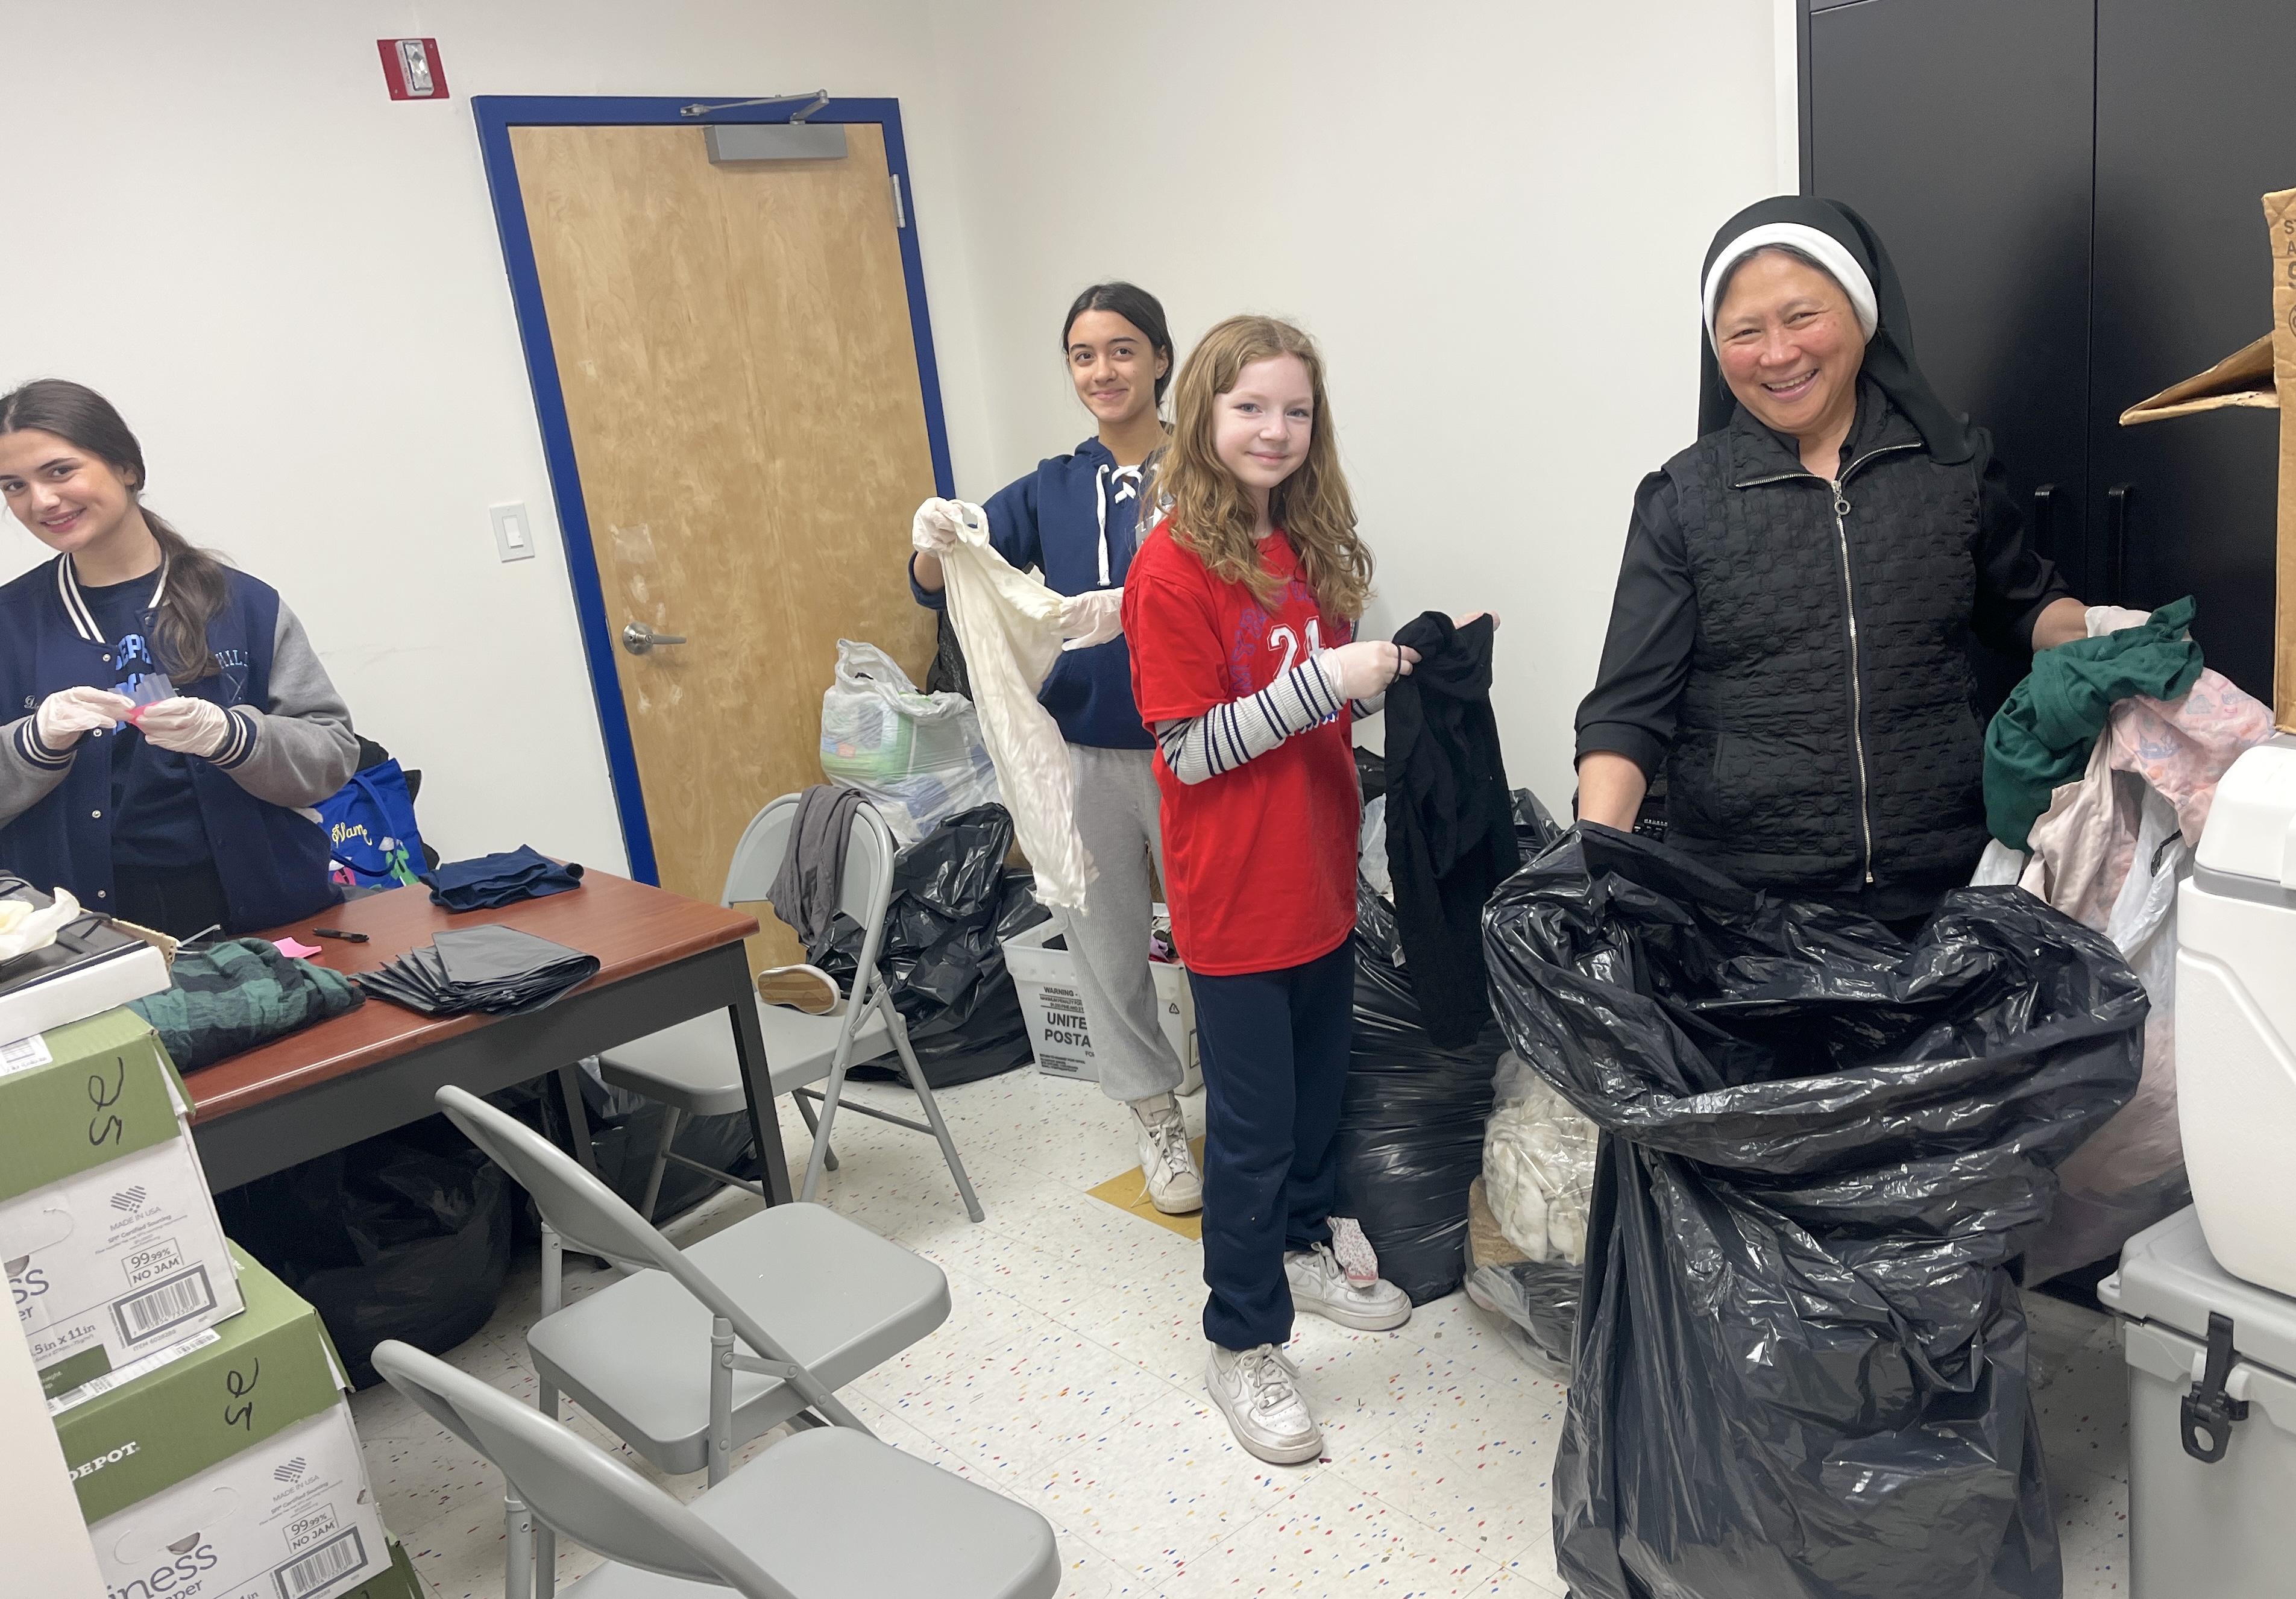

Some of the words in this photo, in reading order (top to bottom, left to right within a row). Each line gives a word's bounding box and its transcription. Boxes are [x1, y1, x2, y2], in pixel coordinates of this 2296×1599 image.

[1267, 615, 1326, 680] 24
[1044, 987, 1074, 996] WARNING
[1047, 1012, 1087, 1030] UNITE
[1045, 1028, 1091, 1048] POSTA
[110, 1216, 134, 1231] MADE
[134, 1212, 144, 1221] IN
[145, 1206, 162, 1216] USA
[132, 1269, 151, 1284] NO
[68, 1325, 96, 1341] 11in
[272, 1486, 295, 1502] MADE
[295, 1481, 304, 1491] IN
[304, 1474, 320, 1486] USA
[292, 1535, 309, 1550] NO
